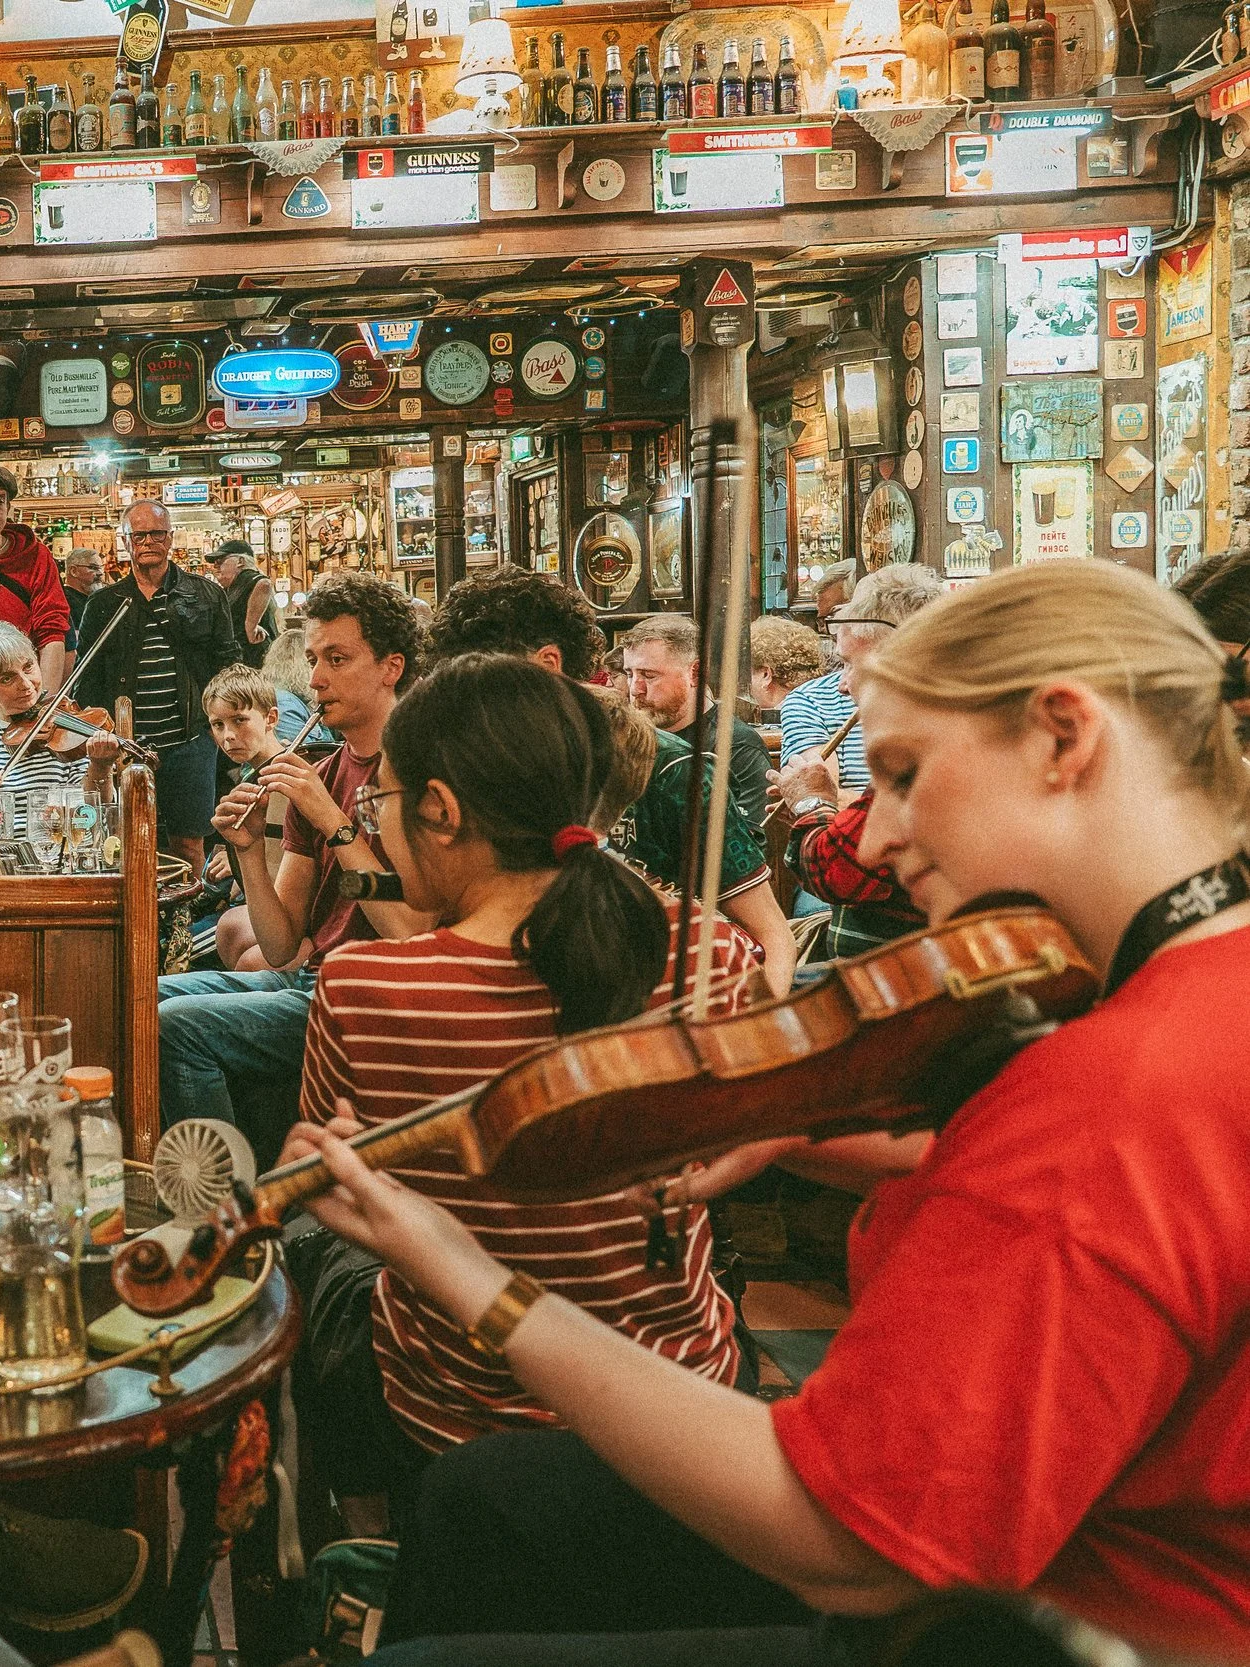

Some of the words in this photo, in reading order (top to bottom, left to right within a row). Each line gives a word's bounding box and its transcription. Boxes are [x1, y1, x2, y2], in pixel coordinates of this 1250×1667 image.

[890, 110, 923, 129] Bass
[1008, 116, 1049, 129] DOUBLE
[1052, 113, 1103, 126] DIAMOND
[704, 131, 798, 148] SMITHWICK'S
[283, 140, 314, 157] Bass
[406, 151, 481, 167] GUINNESS
[407, 167, 426, 175] more
[426, 165, 443, 174] than
[444, 164, 479, 175] goodness
[287, 203, 327, 214] TANKARD
[711, 288, 738, 303] Bass
[1165, 305, 1205, 337] JAMESON
[378, 322, 413, 336] HARP
[221, 369, 271, 383] DRAUGHT
[275, 366, 334, 380] GUINNESS
[48, 386, 61, 394] PURE
[63, 385, 76, 394] MALT
[1119, 418, 1143, 427] HARP
[230, 453, 272, 466] GUINNESS
[1118, 470, 1143, 479] HARP
[956, 501, 976, 510] HARP
[1040, 531, 1067, 541] ПЕЙТЕ
[1119, 526, 1142, 534] HARP
[1038, 545, 1069, 553] ГИНЭСС
